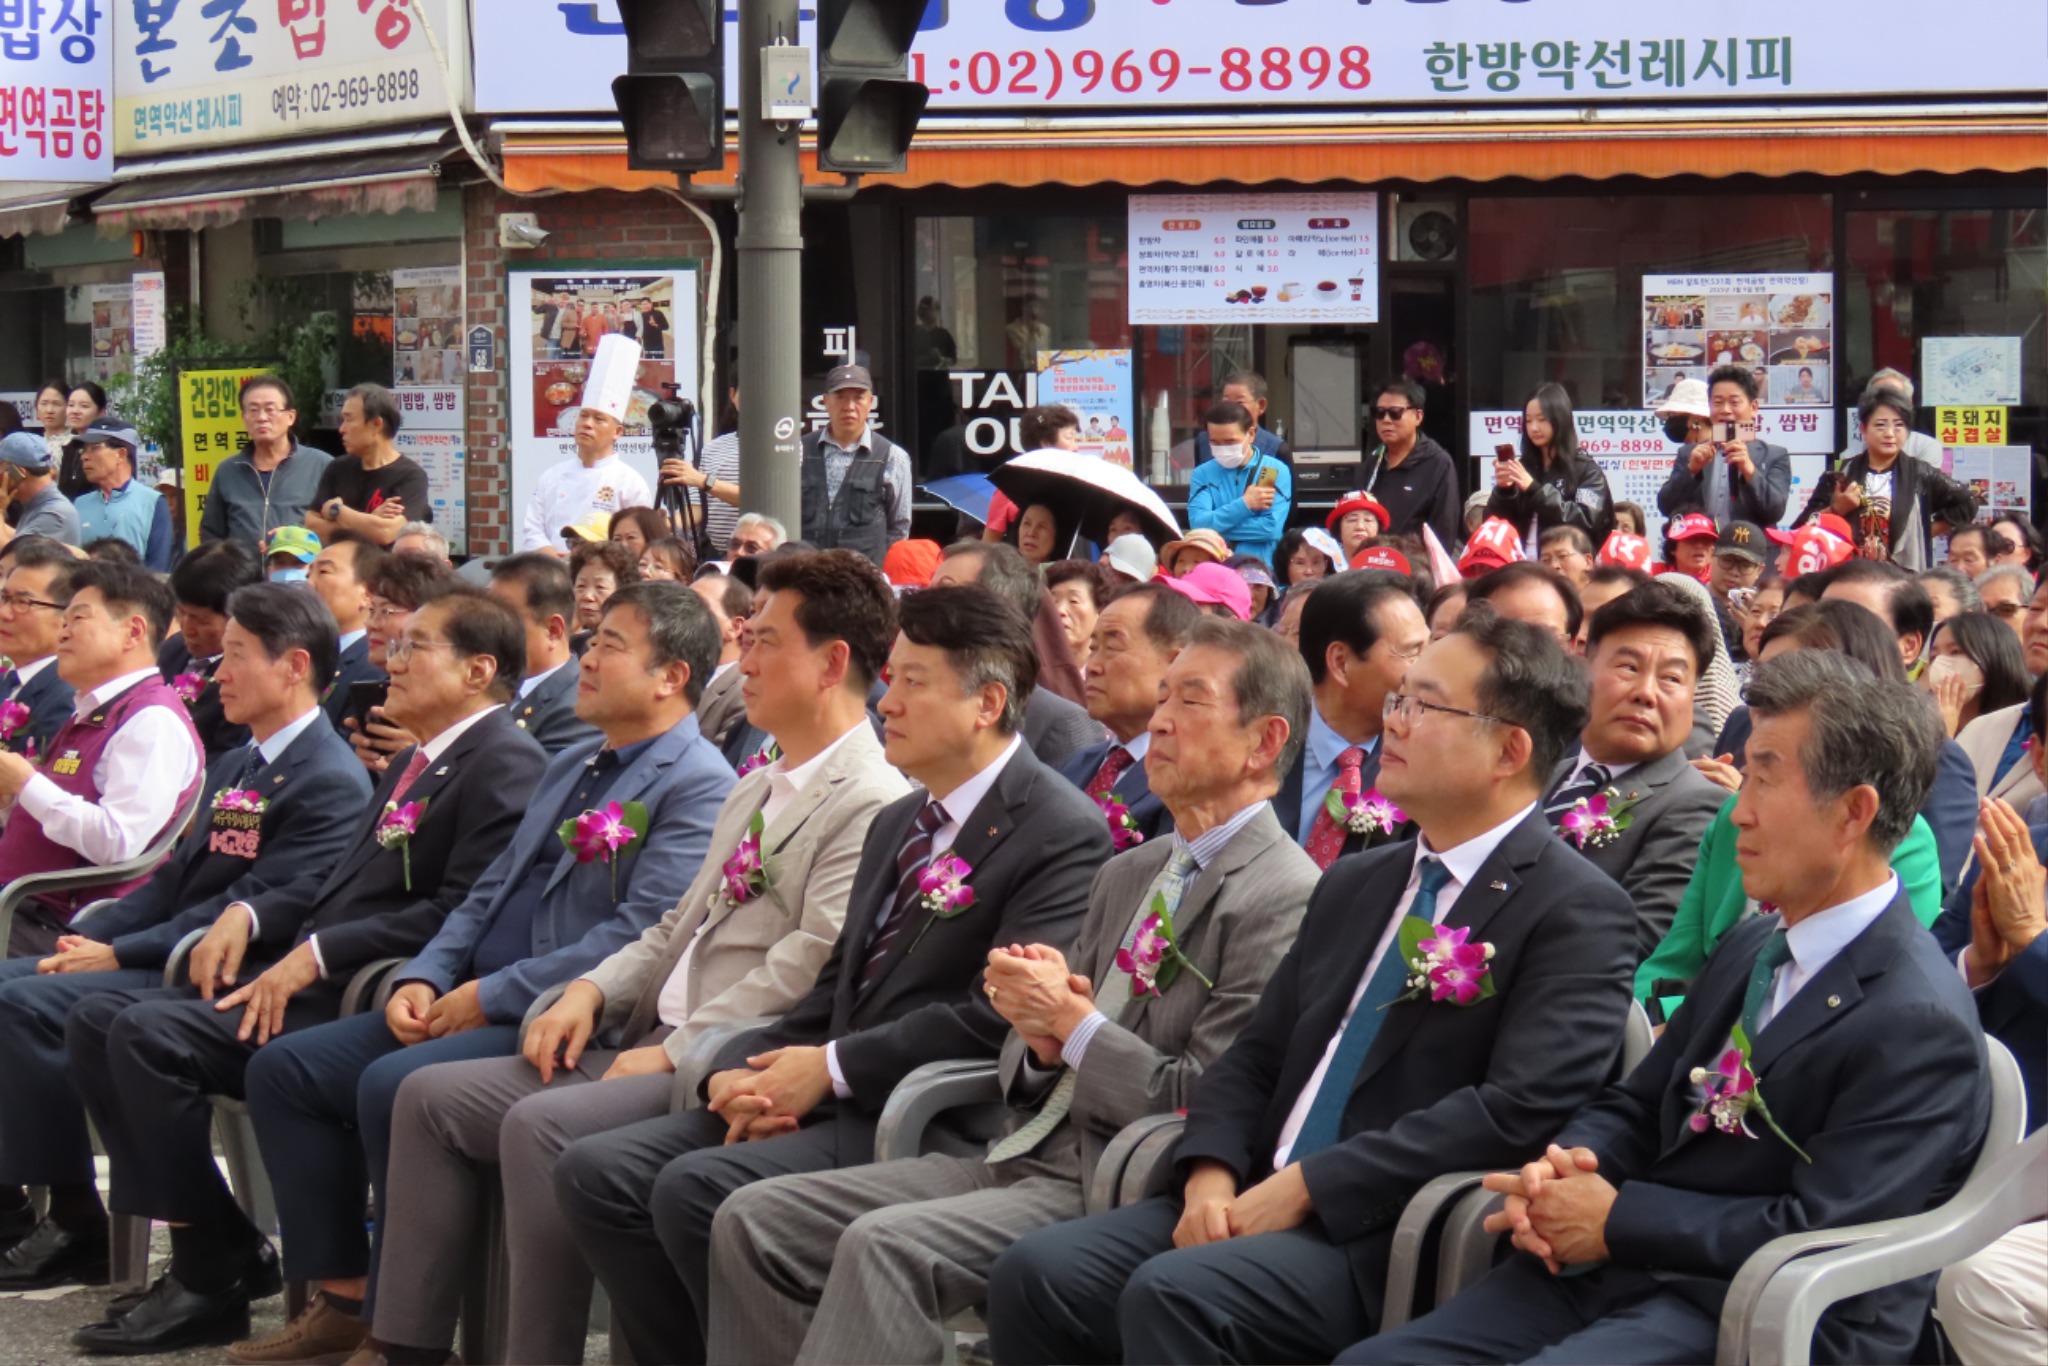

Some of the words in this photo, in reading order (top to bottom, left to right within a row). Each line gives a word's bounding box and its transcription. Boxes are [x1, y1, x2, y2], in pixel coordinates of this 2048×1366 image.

[1423, 36, 1792, 92] 한방약선레시피
[0, 86, 105, 160] 면역곰탕
[134, 100, 193, 140] 면역약선
[196, 93, 242, 130] 레시피
[823, 326, 856, 365] 피
[190, 376, 237, 418] 건강한
[1779, 414, 1819, 432] 쌈밥
[1941, 427, 2001, 443] 삼겹살
[1942, 410, 2000, 426] 흑돼지
[194, 431, 251, 452] 면역곰
